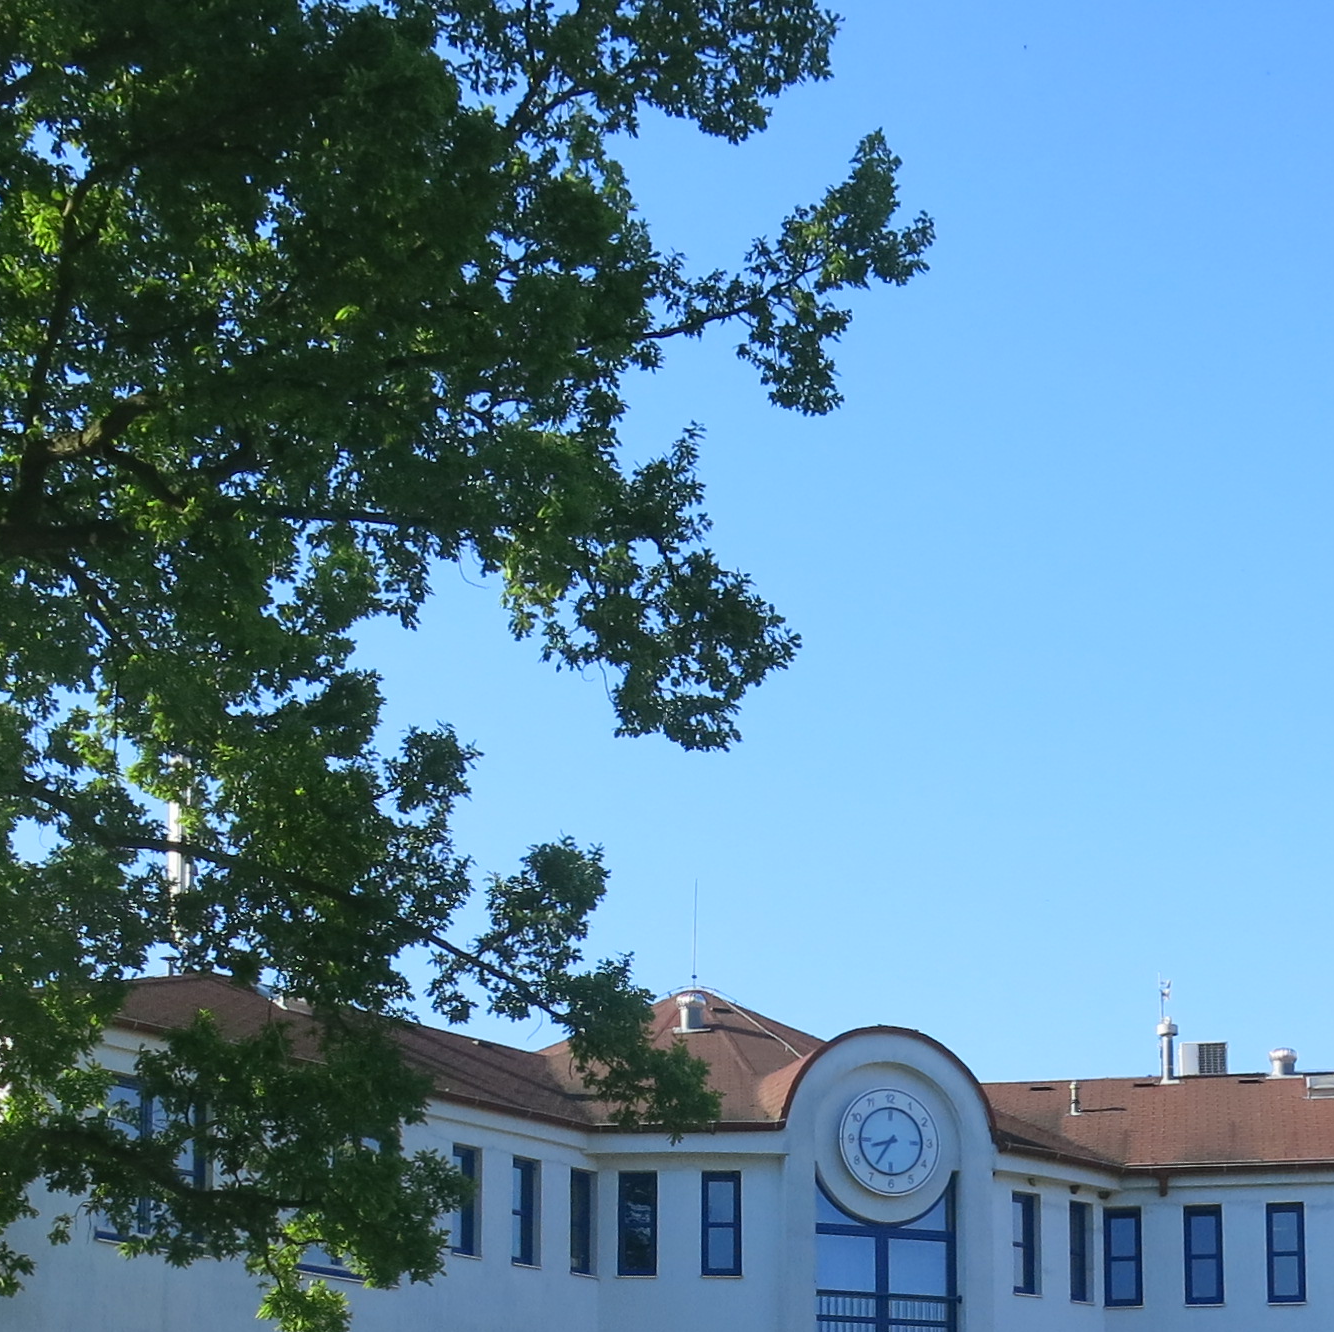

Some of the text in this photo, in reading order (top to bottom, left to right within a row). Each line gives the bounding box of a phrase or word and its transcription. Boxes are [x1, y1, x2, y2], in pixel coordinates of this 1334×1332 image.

[866, 1097, 875, 1108] 11
[885, 1094, 896, 1104] 12
[907, 1101, 913, 1111] 1
[850, 1112, 863, 1123] 10
[920, 1116, 929, 1128] 2
[847, 1133, 855, 1144] 9
[925, 1138, 934, 1149] 3
[853, 1154, 861, 1166] 8
[920, 1158, 927, 1169] 4
[867, 1171, 875, 1182] 7
[907, 1174, 915, 1185] 5
[887, 1178, 895, 1189] 6
